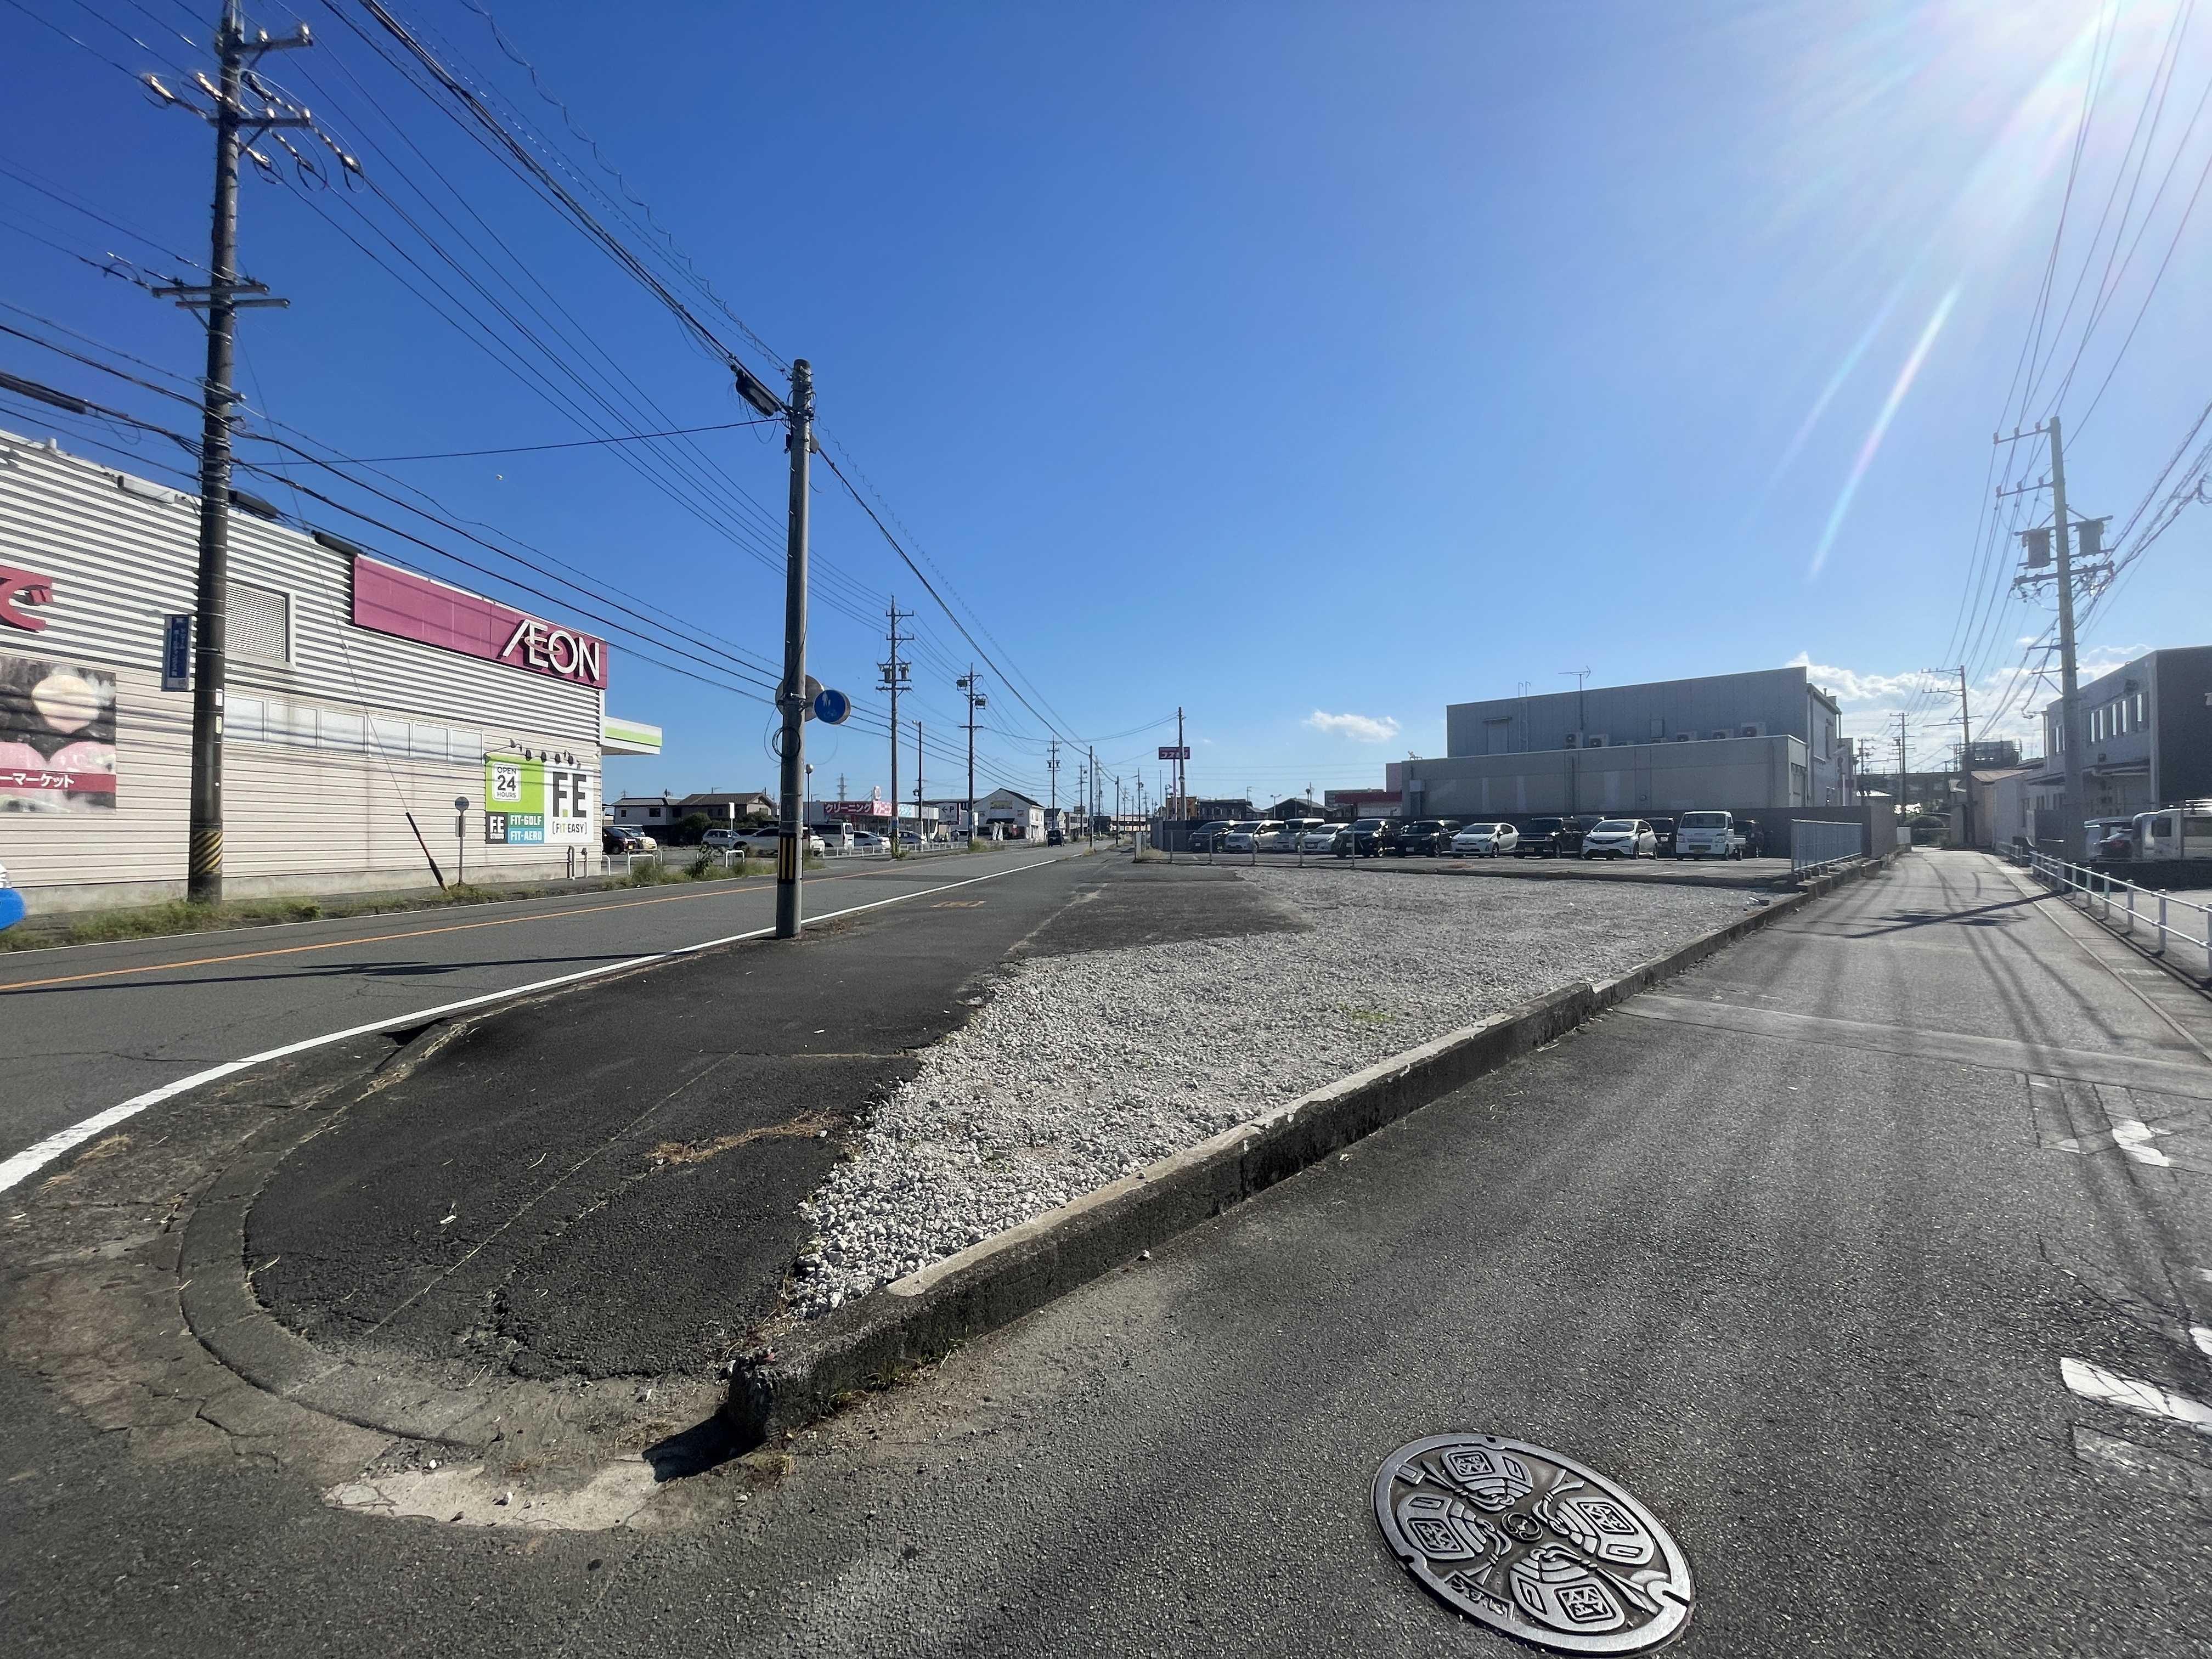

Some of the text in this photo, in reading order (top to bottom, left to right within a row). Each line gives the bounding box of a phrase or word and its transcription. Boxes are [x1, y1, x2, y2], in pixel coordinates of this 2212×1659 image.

[497, 766, 516, 775] OPEN
[497, 775, 516, 792] 24
[825, 803, 872, 813] クリーニング
